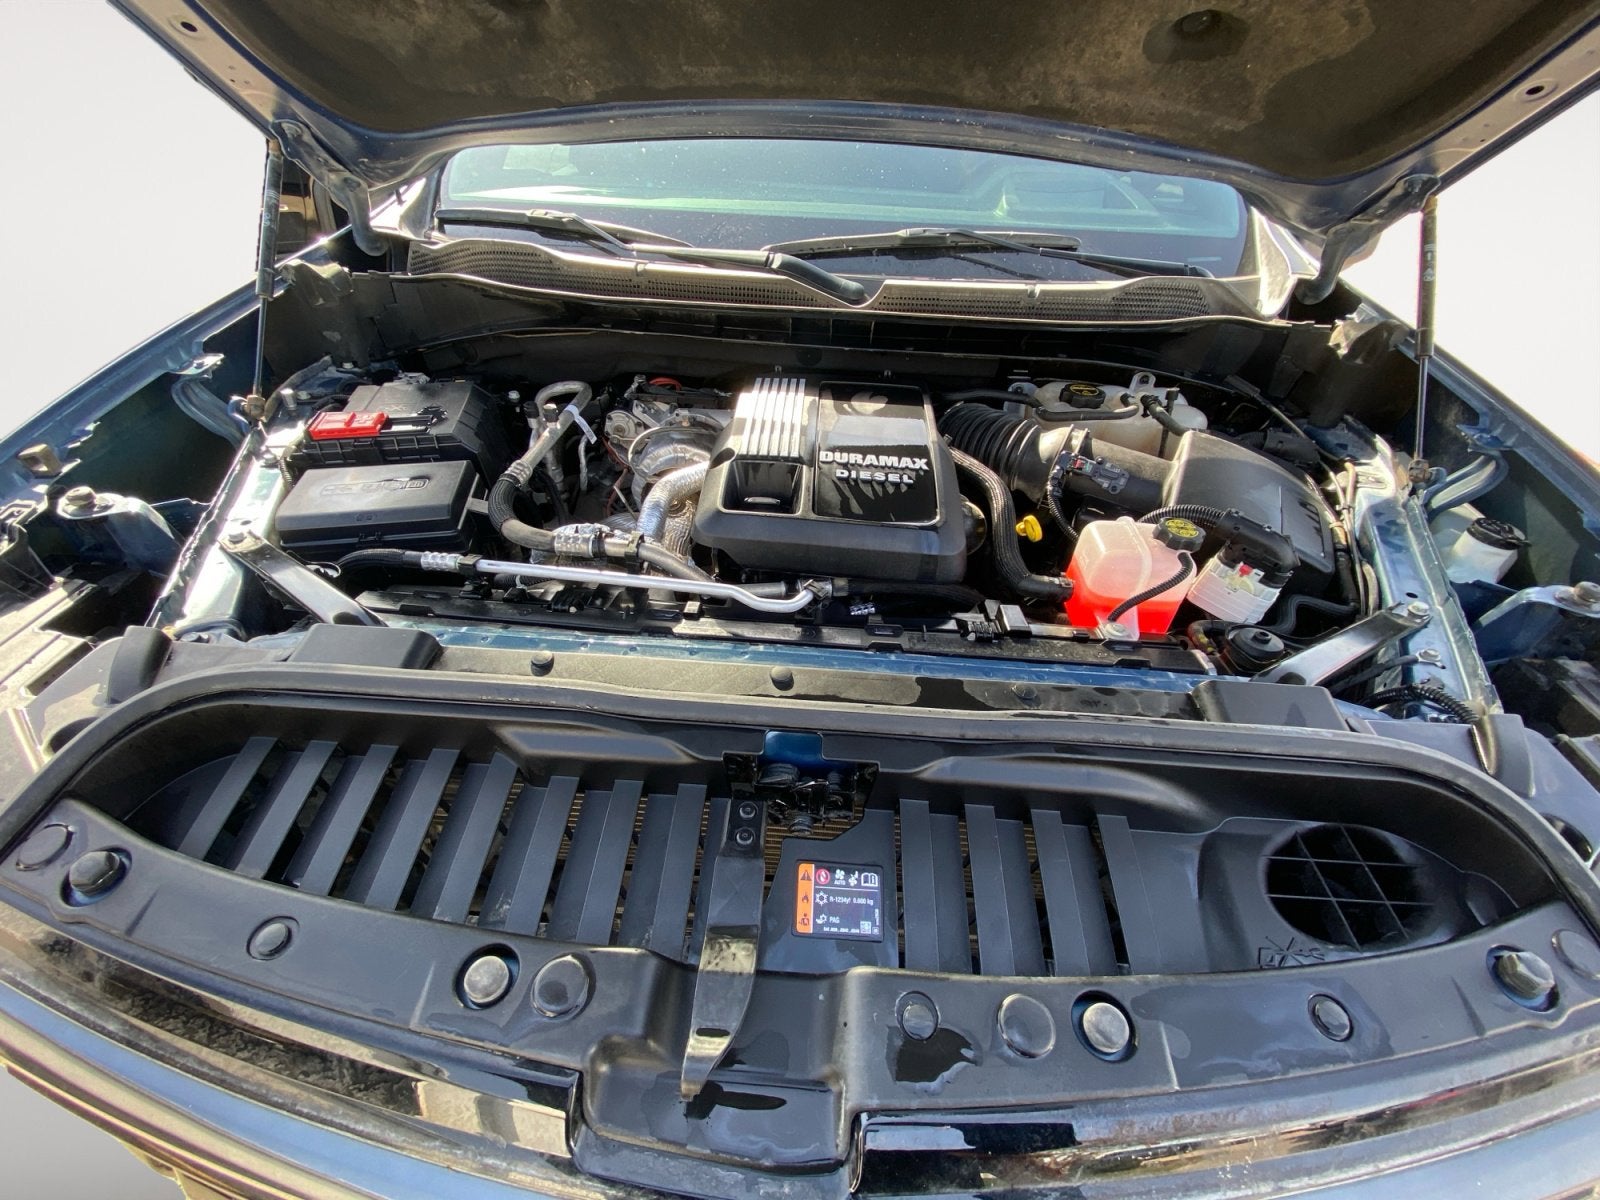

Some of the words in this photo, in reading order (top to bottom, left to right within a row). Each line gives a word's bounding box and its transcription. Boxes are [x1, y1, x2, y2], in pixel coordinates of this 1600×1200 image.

[819, 451, 929, 470] DURAMAX
[836, 469, 914, 484] DIESEL
[867, 898, 874, 906] kg
